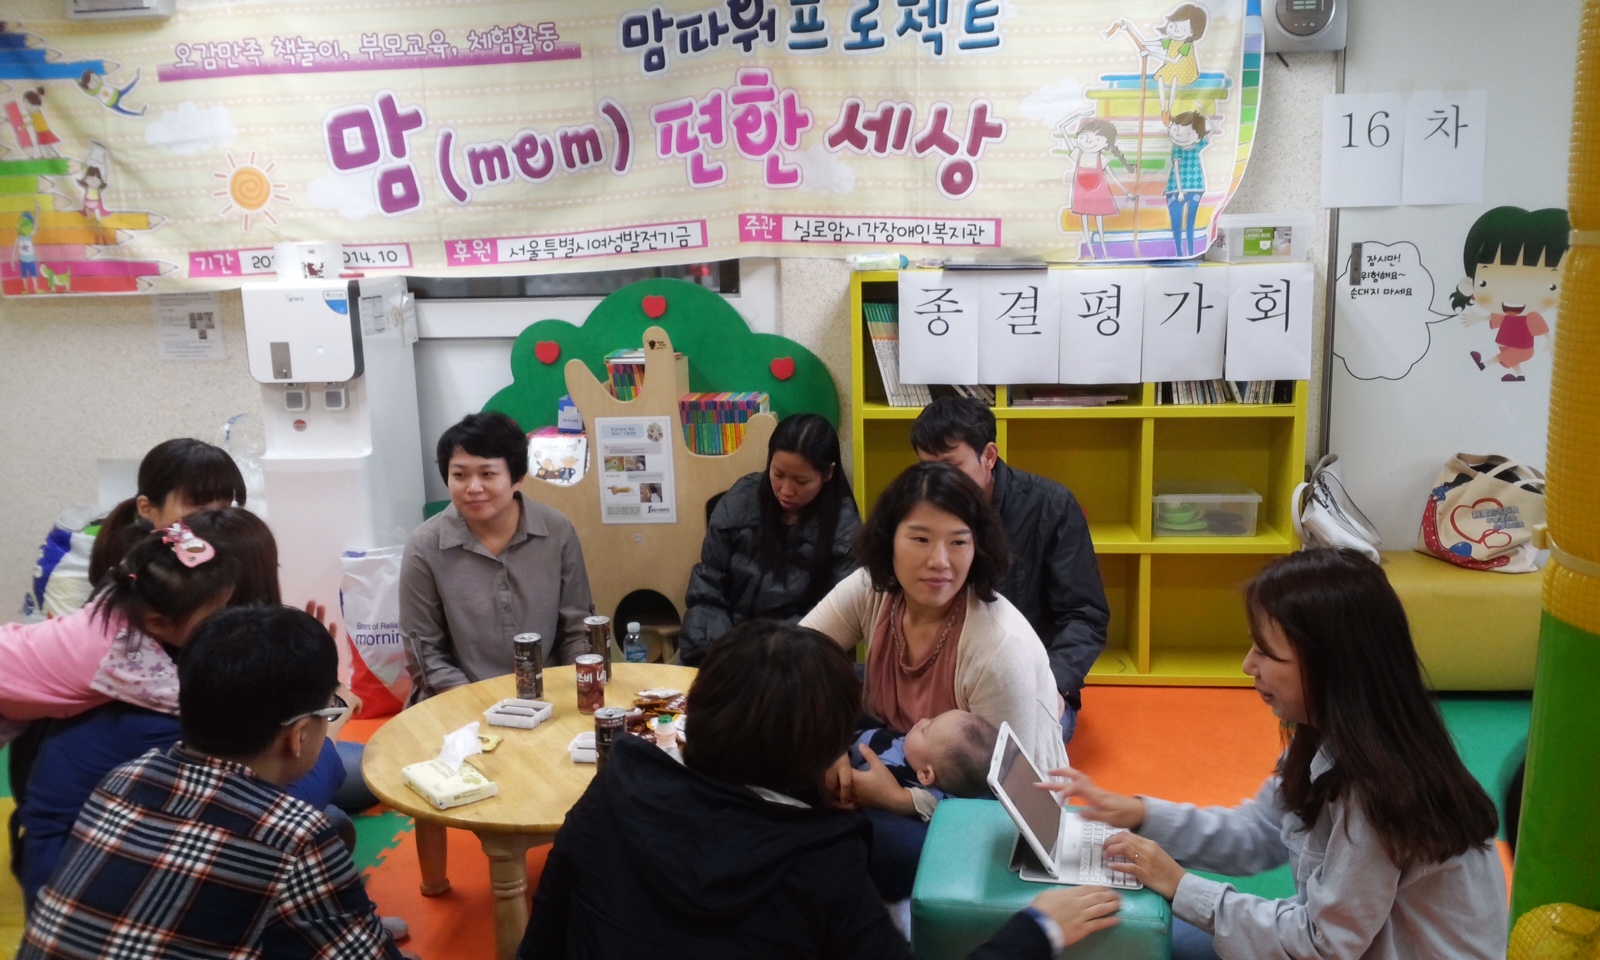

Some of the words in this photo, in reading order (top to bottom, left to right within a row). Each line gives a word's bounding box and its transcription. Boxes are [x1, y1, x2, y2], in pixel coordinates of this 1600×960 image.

[174, 37, 264, 71] 오감만족
[271, 35, 350, 67] 책놀이,
[359, 29, 459, 61] 부모교육,
[467, 22, 560, 56] 체험활동
[827, 101, 1003, 196] 세상
[453, 239, 492, 263] 후원
[508, 226, 692, 262] 서울특별시여성발전기금
[744, 215, 777, 240] 주관
[793, 219, 986, 245] 실로암시각장애인복지관
[194, 252, 234, 275] 기간
[1366, 253, 1402, 267] 잠시만!
[1350, 287, 1380, 300] 손대지
[1383, 287, 1413, 297] 마세요
